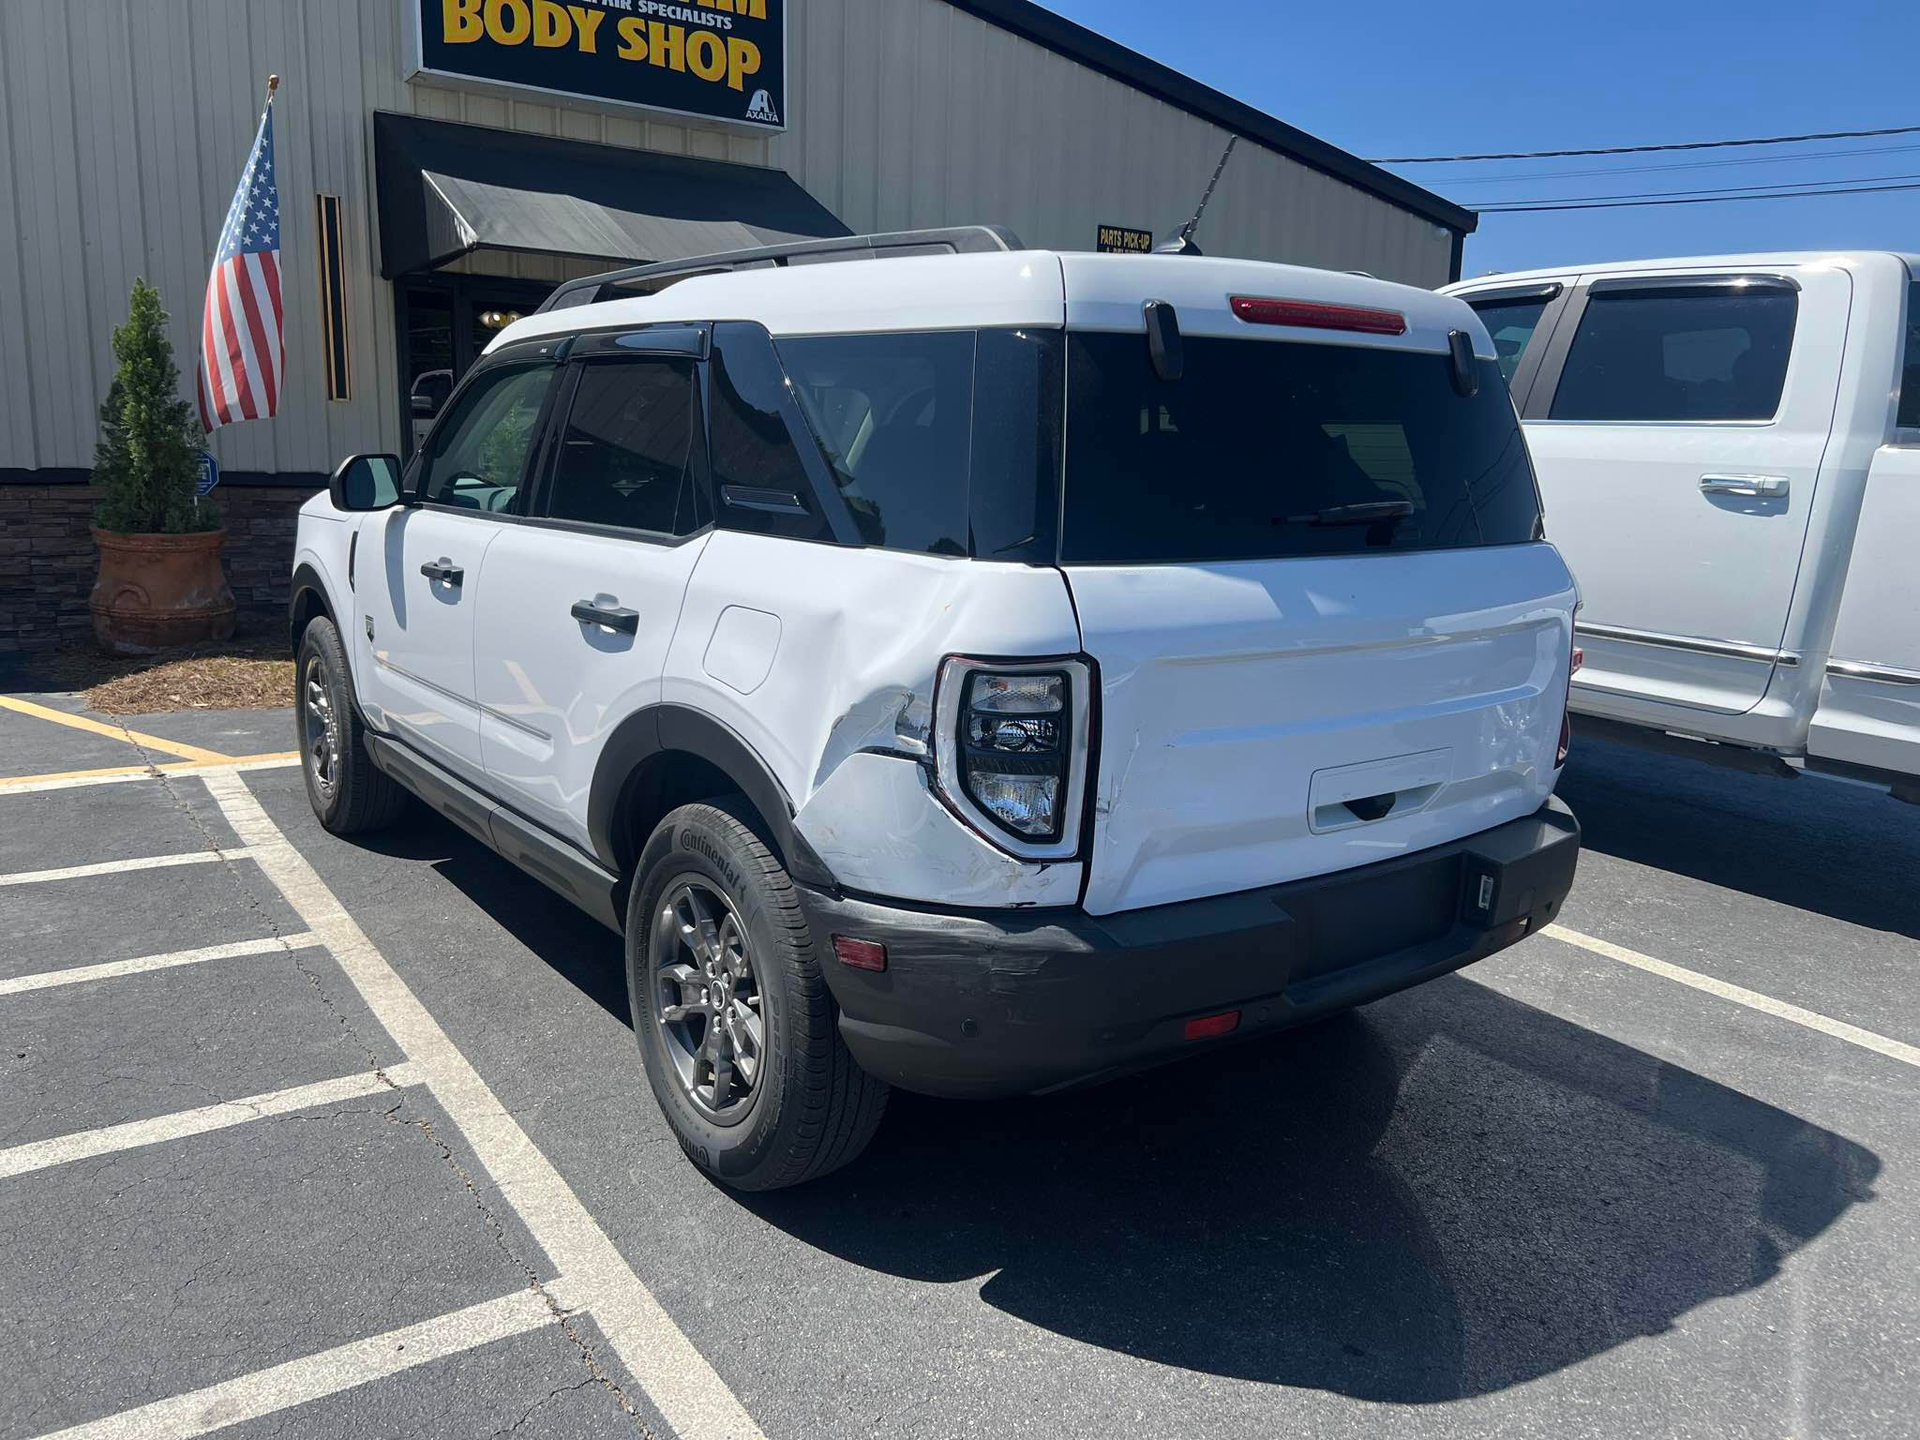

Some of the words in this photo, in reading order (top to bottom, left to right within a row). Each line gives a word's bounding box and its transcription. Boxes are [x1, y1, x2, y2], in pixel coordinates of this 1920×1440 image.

[638, 1, 732, 30] SPECIALISTS
[443, 0, 605, 53] BODY
[617, 17, 761, 91] SHOP
[745, 110, 779, 122] AXALTA
[1101, 229, 1121, 246] PARTS
[1124, 232, 1150, 249] PICK-UP
[681, 828, 740, 889] Continental
